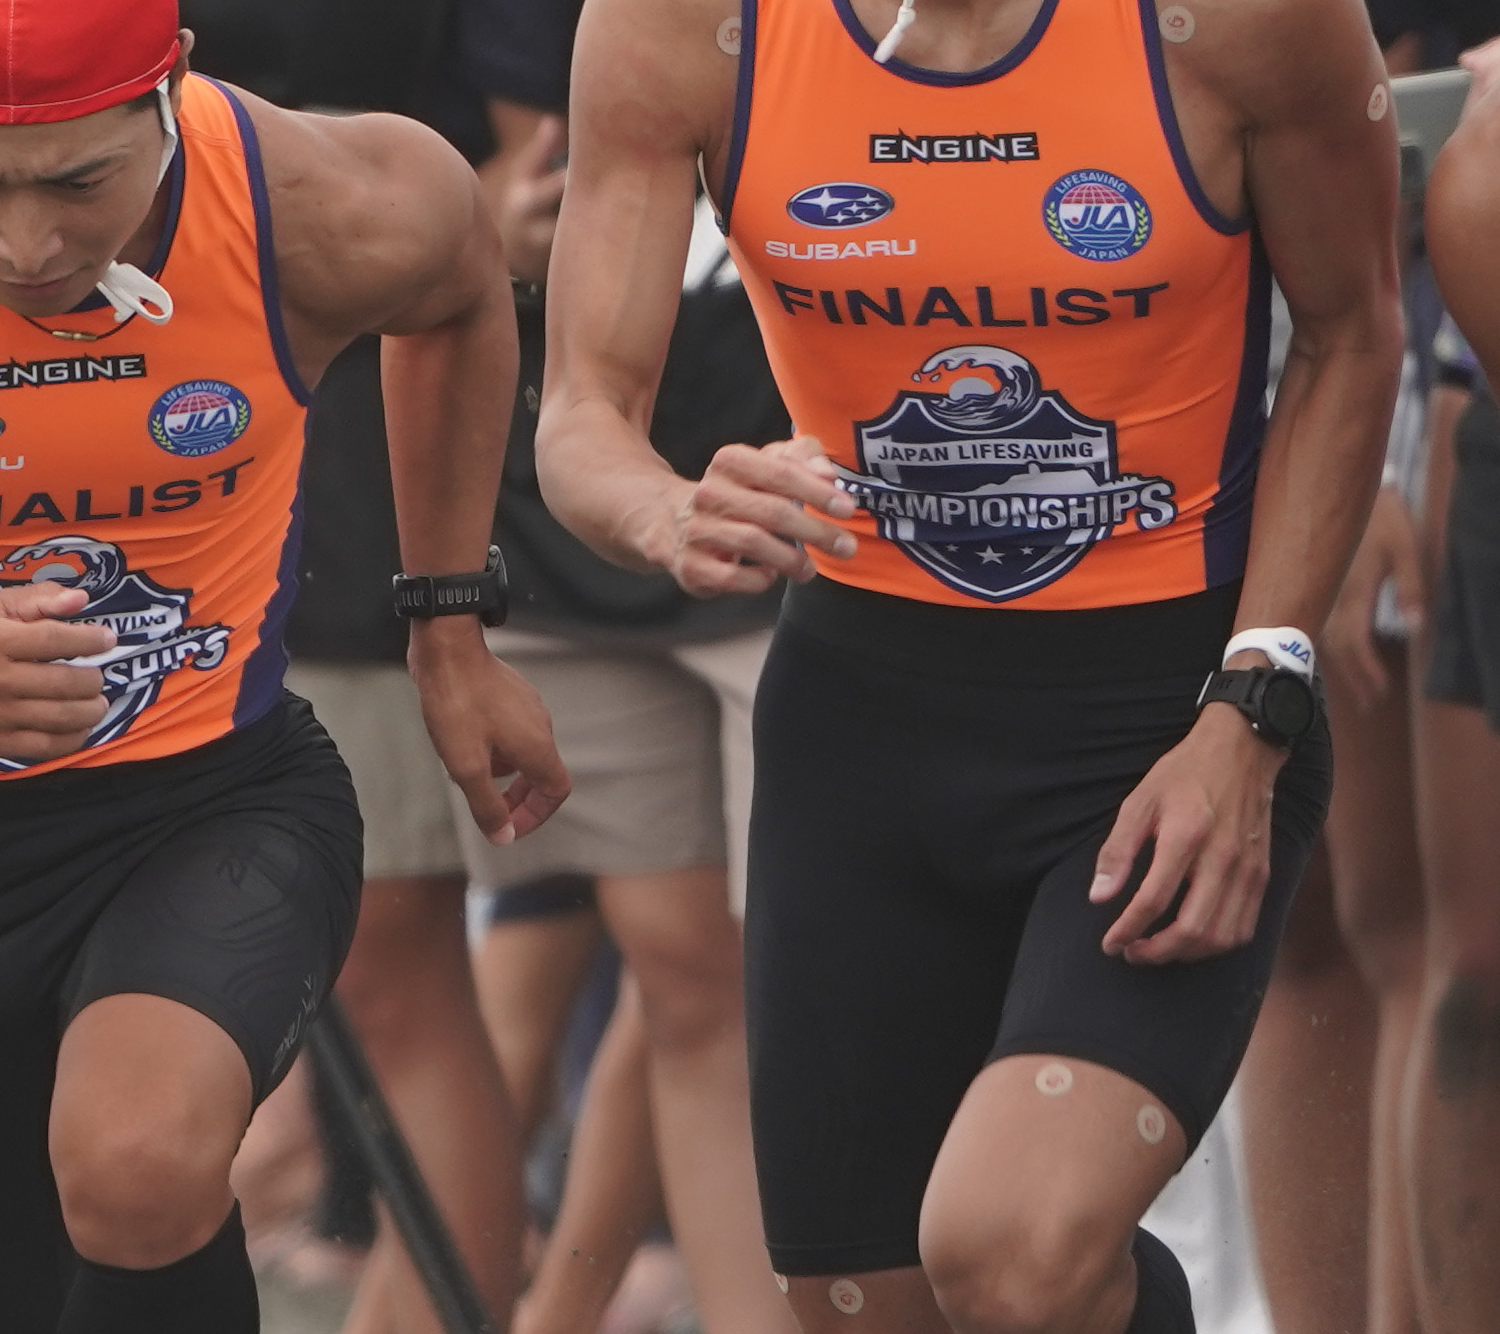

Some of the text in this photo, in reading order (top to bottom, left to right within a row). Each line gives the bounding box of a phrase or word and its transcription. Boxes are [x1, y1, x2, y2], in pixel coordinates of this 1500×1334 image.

[873, 134, 1037, 159] ENGINE
[1054, 171, 1128, 194] LIFESAVING
[1063, 204, 1131, 229] JLA
[765, 238, 917, 261] SUBARU
[1078, 247, 1129, 260] JAPAN
[772, 280, 1170, 328] FINALIST
[161, 381, 232, 406] LIFESAVING
[168, 407, 232, 435] JLA
[181, 440, 228, 455] JAPAN
[877, 441, 1094, 462] JAPAN LIFESAVING
